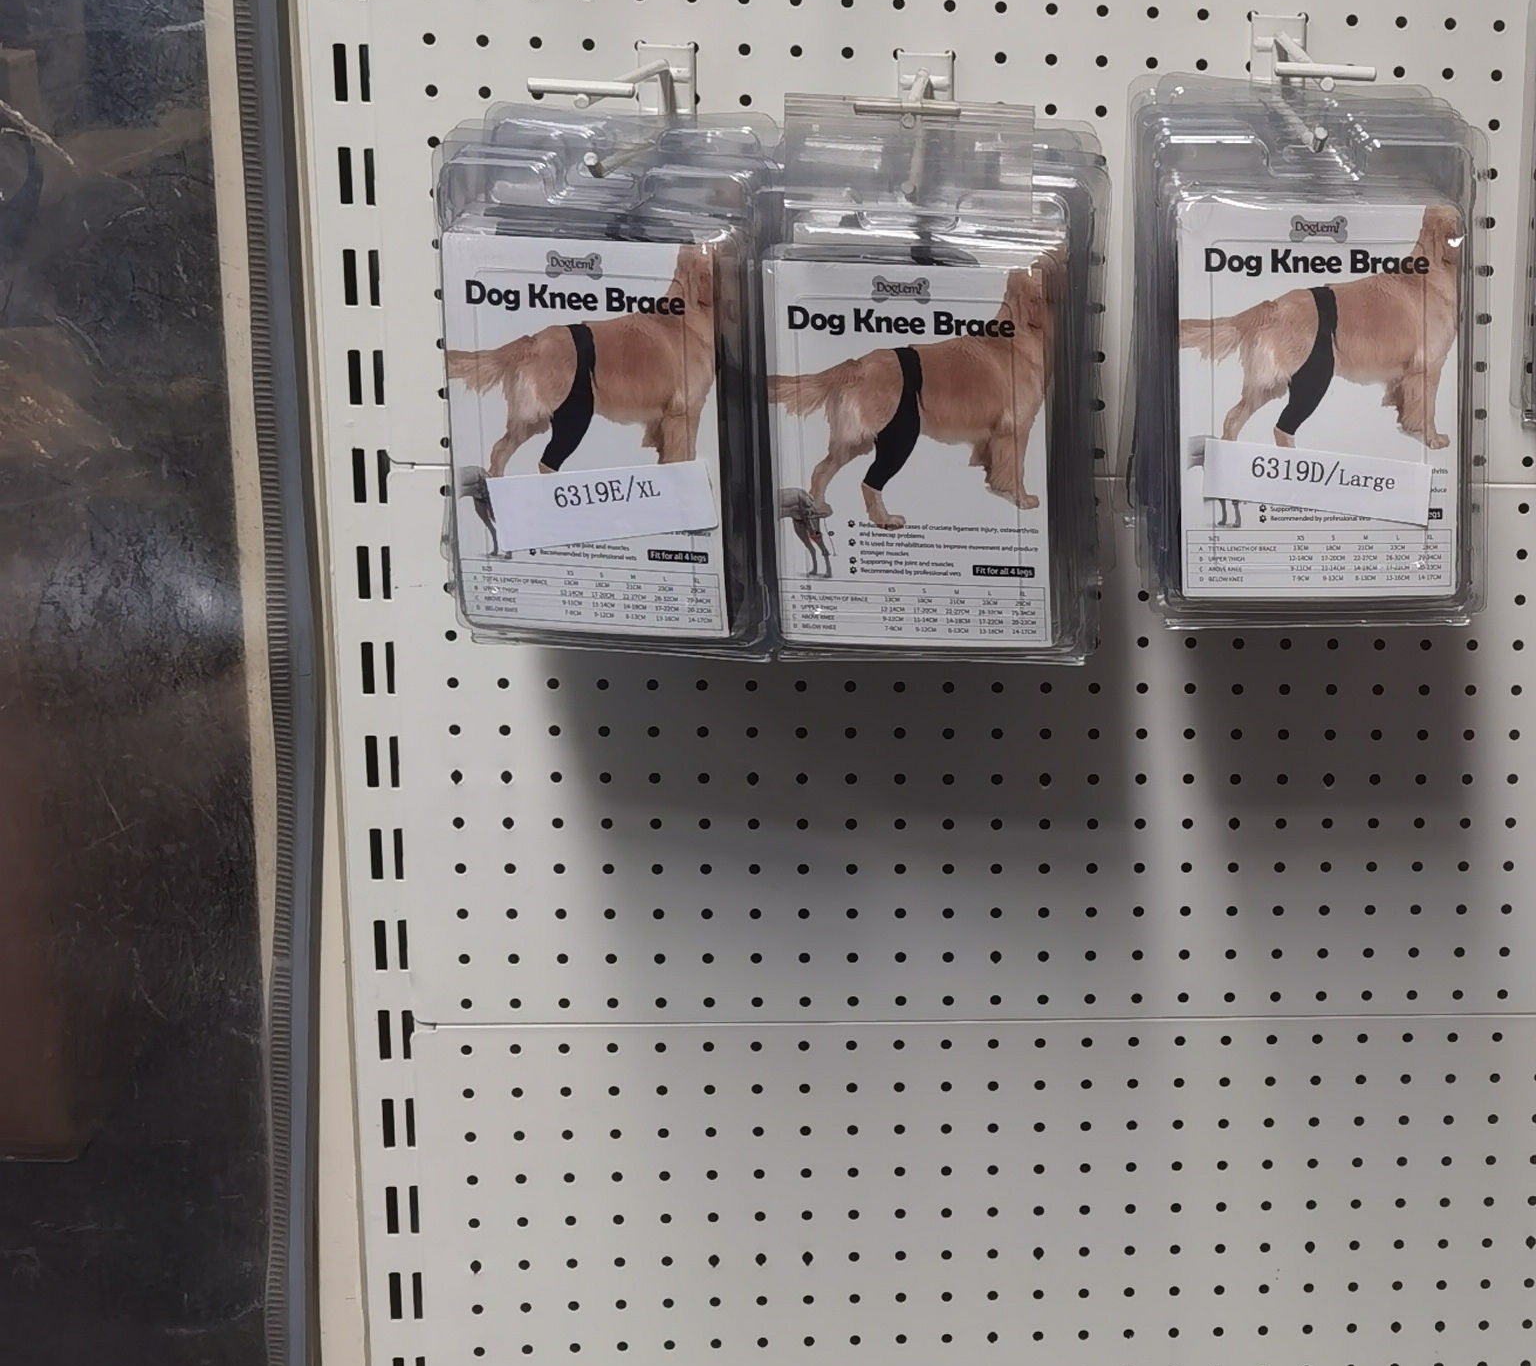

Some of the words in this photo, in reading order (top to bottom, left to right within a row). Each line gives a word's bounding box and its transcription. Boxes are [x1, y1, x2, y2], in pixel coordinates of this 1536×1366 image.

[1204, 248, 1262, 276] Dog
[1271, 249, 1342, 273] Knee
[1350, 249, 1430, 274] Brace
[465, 280, 520, 311] Dog
[528, 284, 598, 310] Knee
[606, 287, 685, 315] Brace
[787, 305, 845, 335] Dog
[853, 308, 925, 334] Knee
[933, 311, 1015, 337] Brace
[1252, 456, 1395, 492] 6319D/Large
[554, 475, 661, 508] 6319E/XL
[650, 551, 661, 560] Fit
[661, 552, 672, 560] for
[674, 553, 683, 561] all
[685, 553, 690, 561] 4
[691, 554, 706, 563] legs
[987, 567, 998, 575] for
[1000, 567, 1009, 575] all
[1017, 568, 1033, 577] legs
